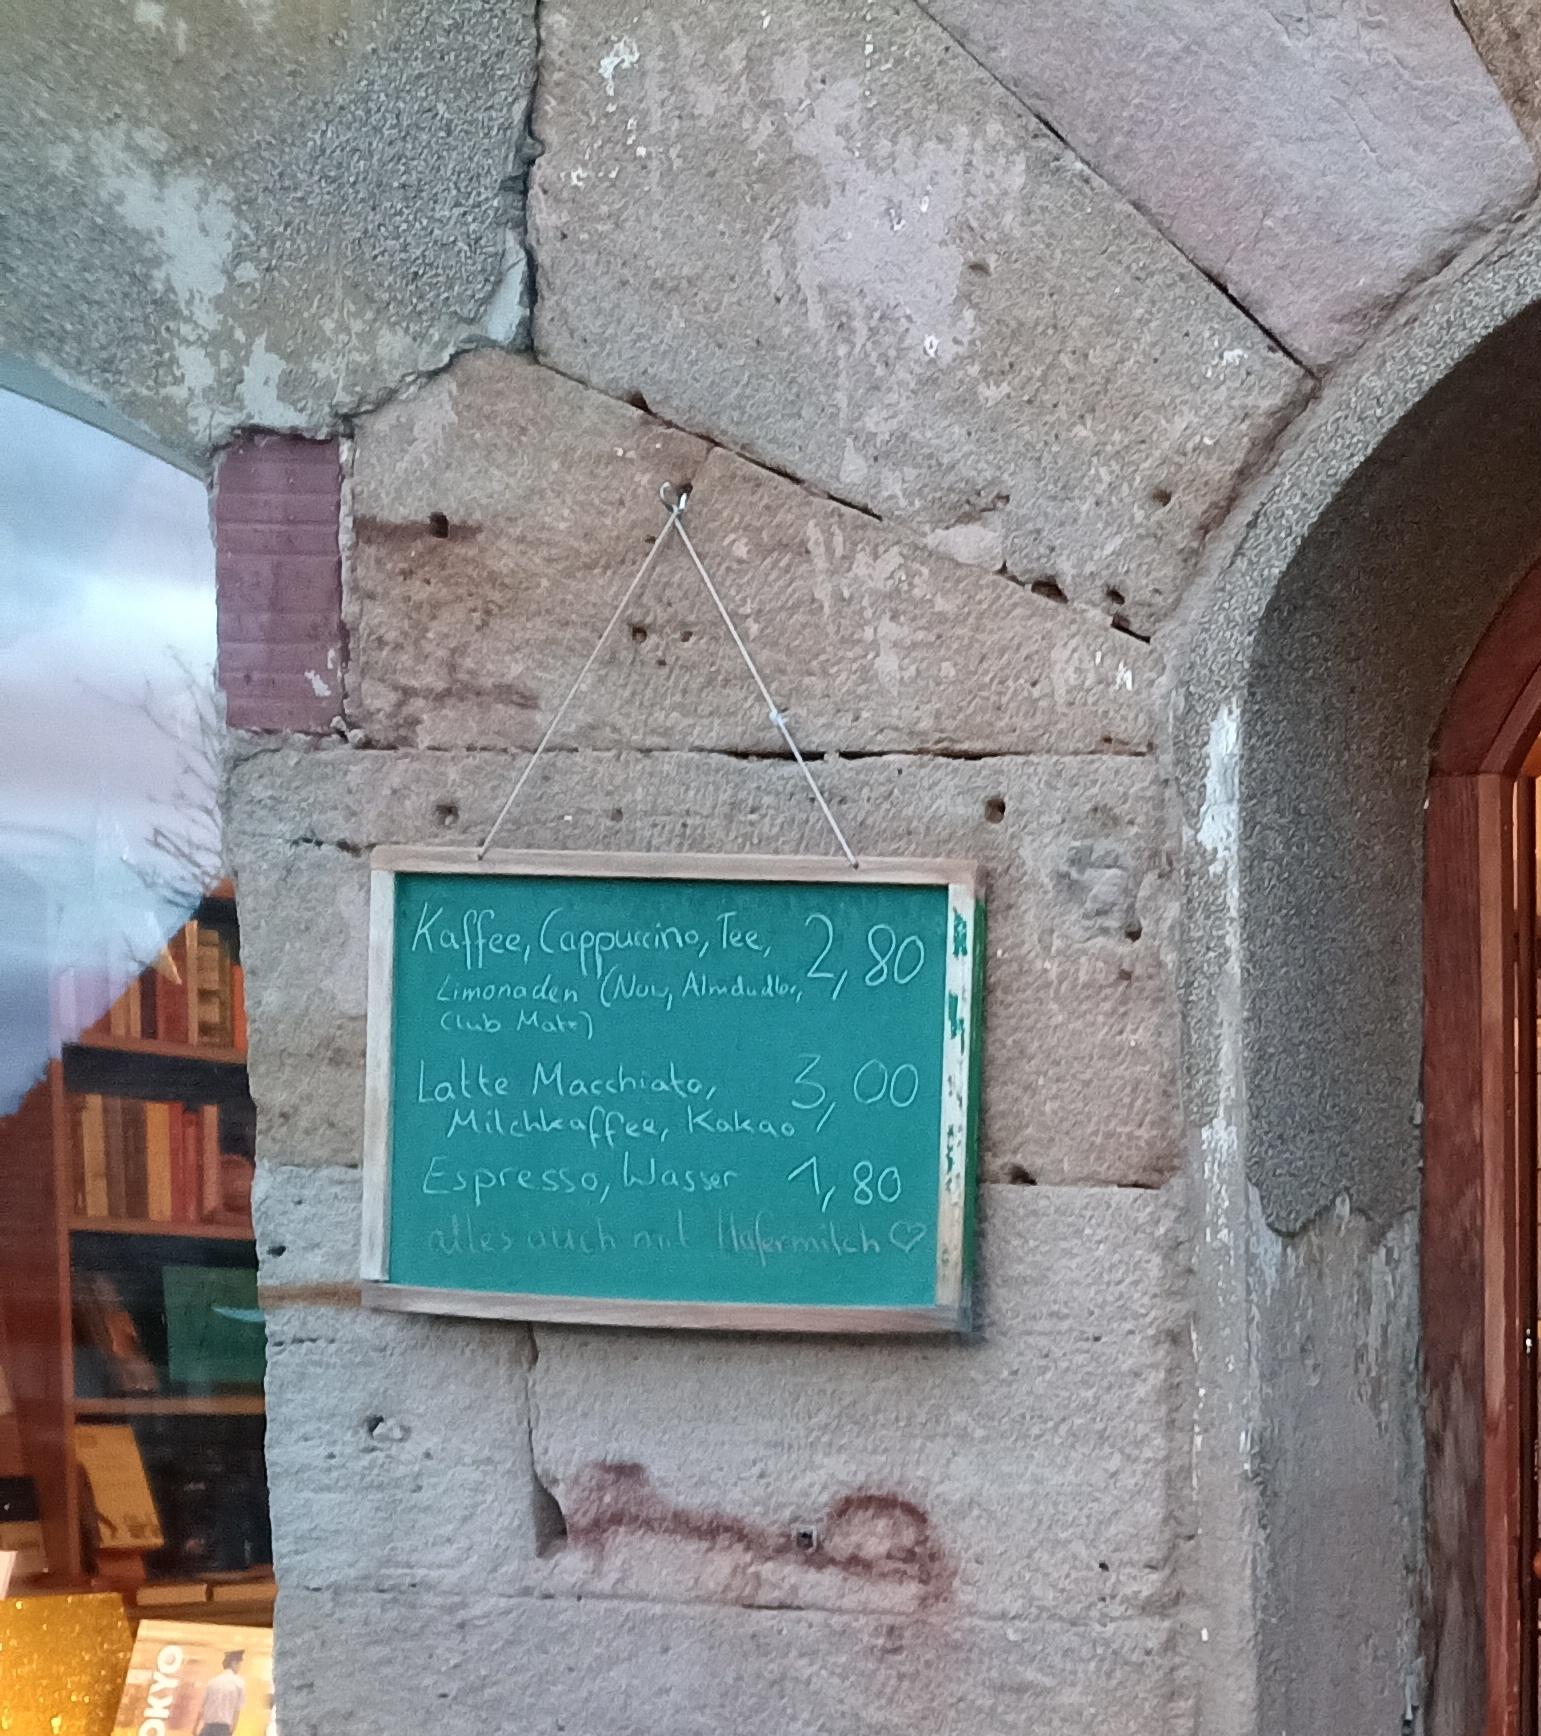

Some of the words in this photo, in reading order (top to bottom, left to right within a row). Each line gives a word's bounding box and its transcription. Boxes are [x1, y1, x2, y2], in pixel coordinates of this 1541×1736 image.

[412, 902, 530, 970] Kaffee,
[540, 907, 709, 980] Cappuccino,
[716, 911, 771, 957] Tee,
[804, 913, 925, 1001] 2,80
[437, 973, 578, 1004] Limonaden
[516, 1009, 593, 1040] Mate)
[418, 1057, 509, 1102] Latte
[532, 1061, 716, 1100] Macchiato,
[791, 1053, 919, 1133] 3,00
[447, 1106, 669, 1149] Milchkaffee,
[687, 1105, 796, 1138] Kakao
[423, 1156, 609, 1207] Espresso,
[623, 1151, 738, 1192] Wasser
[787, 1155, 901, 1213] 1,80
[527, 1221, 616, 1253] auch
